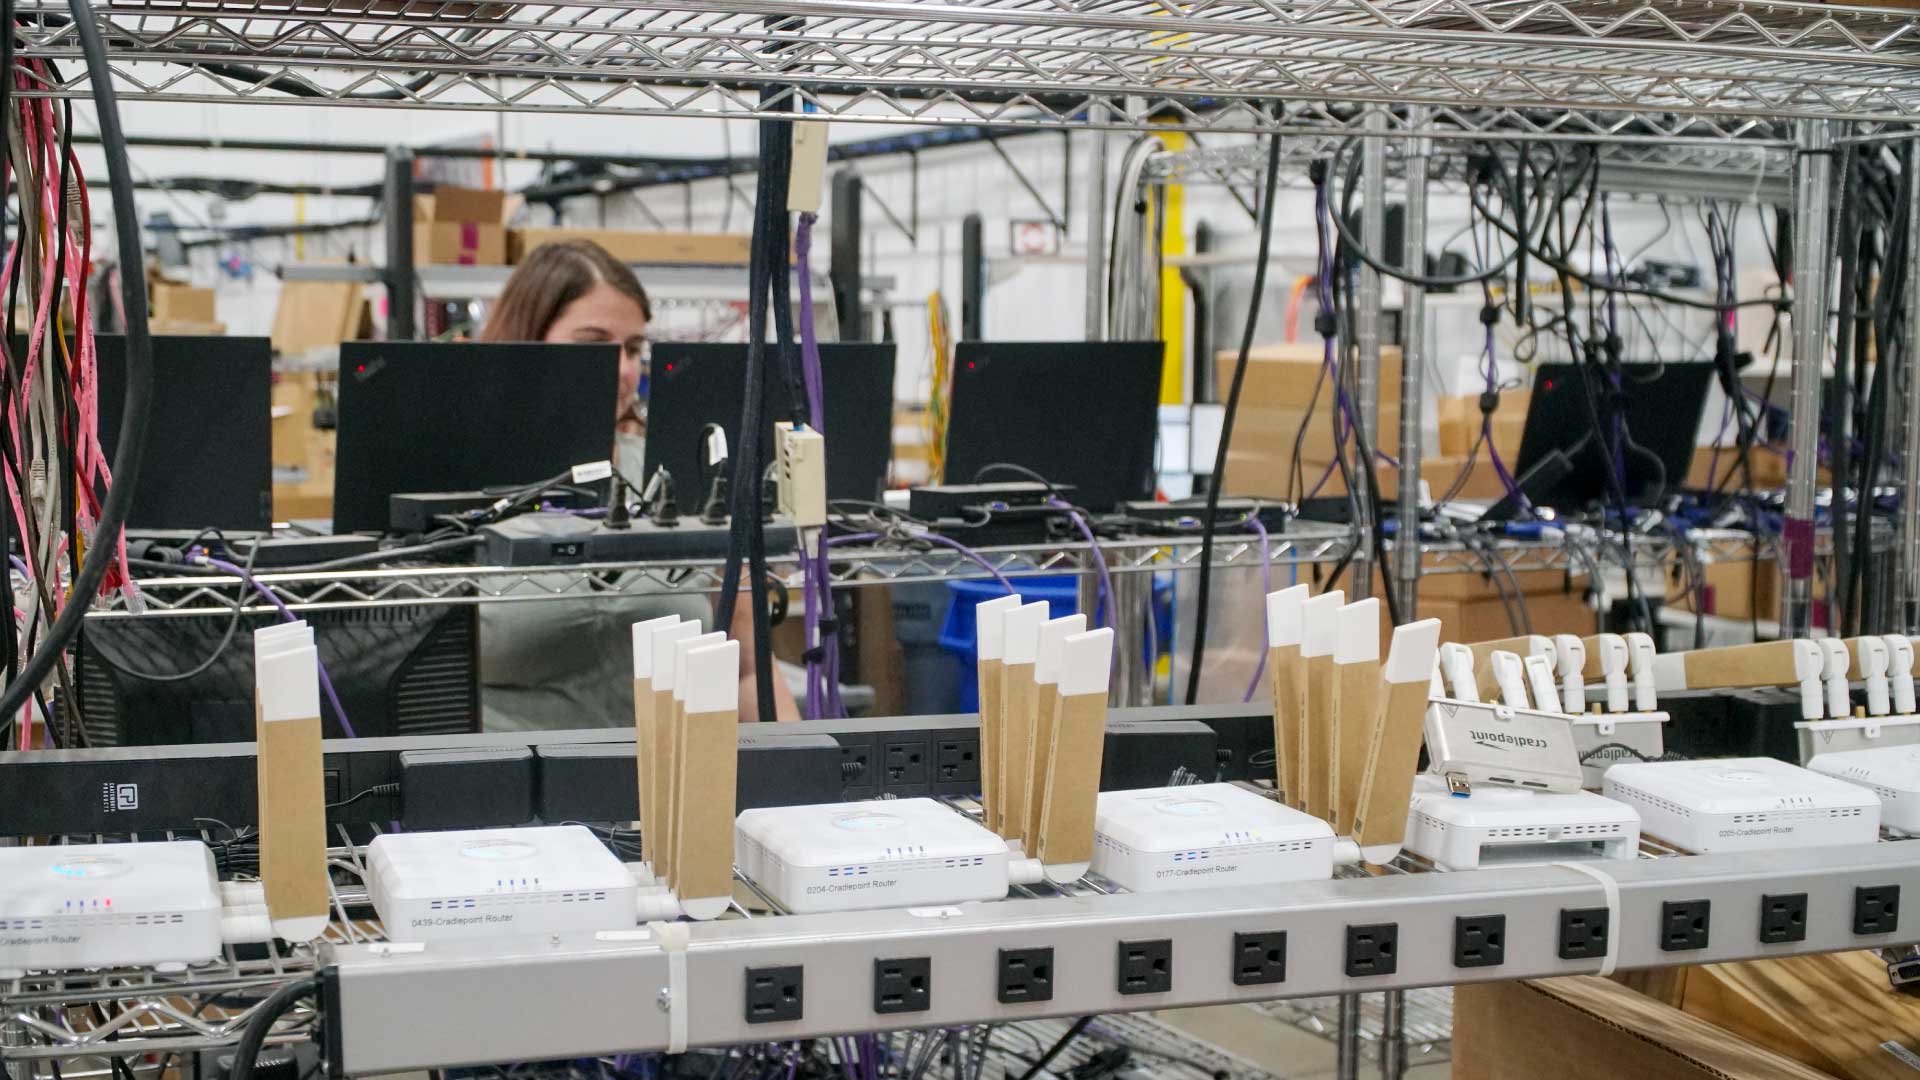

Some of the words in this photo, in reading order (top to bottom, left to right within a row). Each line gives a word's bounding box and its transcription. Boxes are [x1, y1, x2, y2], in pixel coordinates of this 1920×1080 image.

[1469, 730, 1547, 749] cradlepoint
[1156, 866, 1214, 878] 0177-Cradlepoint
[1215, 865, 1238, 873] Router
[806, 882, 871, 894] 0204-Cradlepoint
[872, 880, 897, 888] Router
[411, 915, 483, 928] 0439-Cradlepoint
[485, 914, 513, 923] Router
[51, 934, 81, 943] Router
